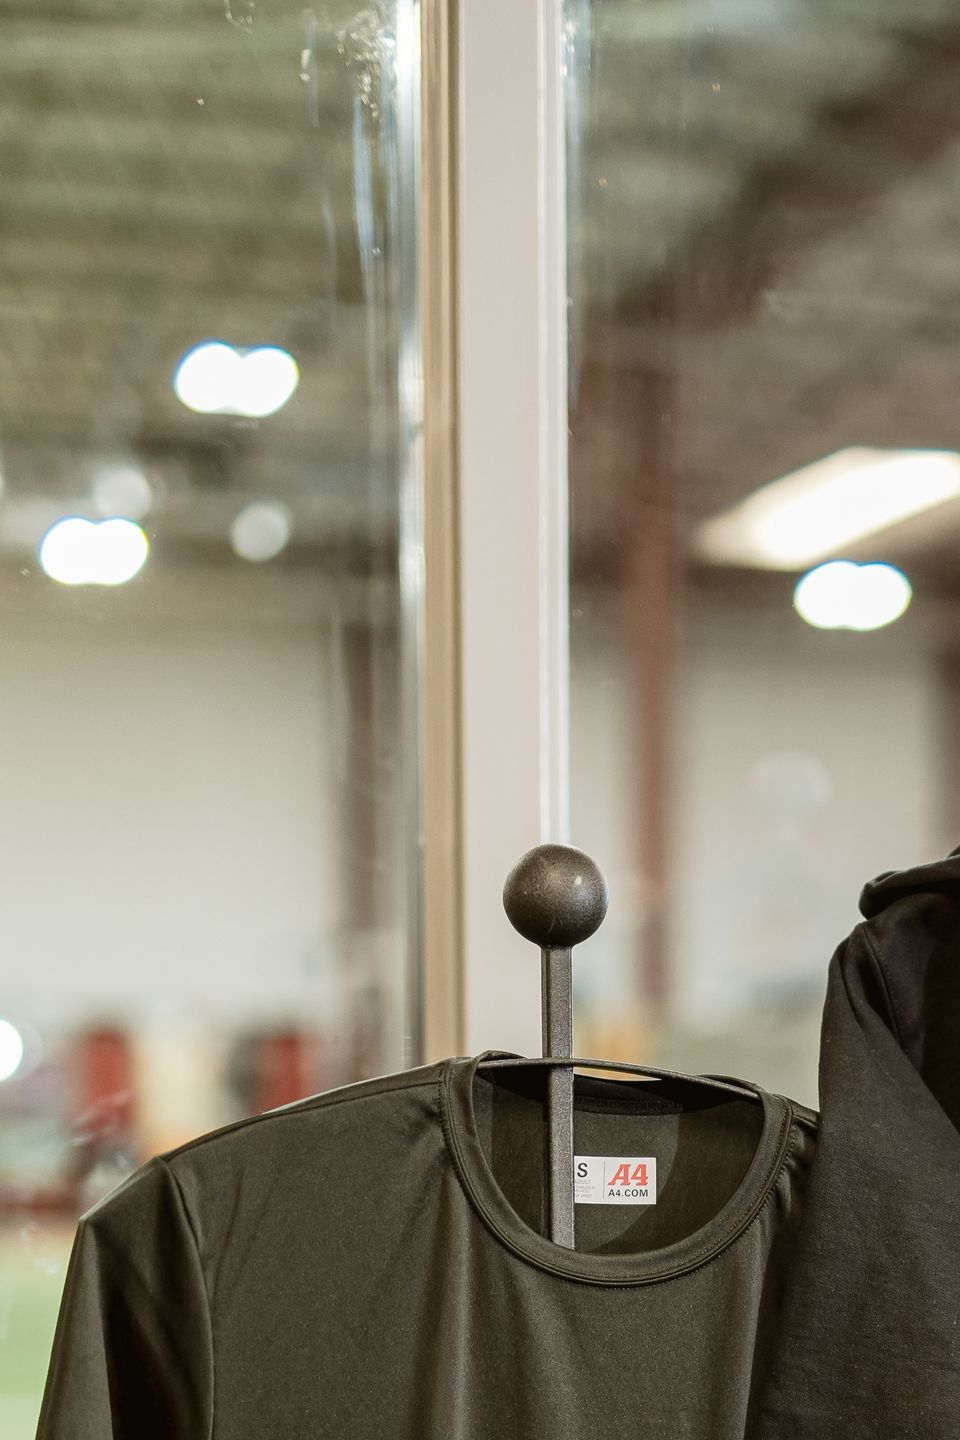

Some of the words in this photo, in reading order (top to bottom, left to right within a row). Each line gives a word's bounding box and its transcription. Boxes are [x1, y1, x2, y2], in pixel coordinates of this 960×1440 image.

[576, 1162, 588, 1178] S
[607, 1163, 648, 1186] A4
[608, 1189, 648, 1198] A4.COM
